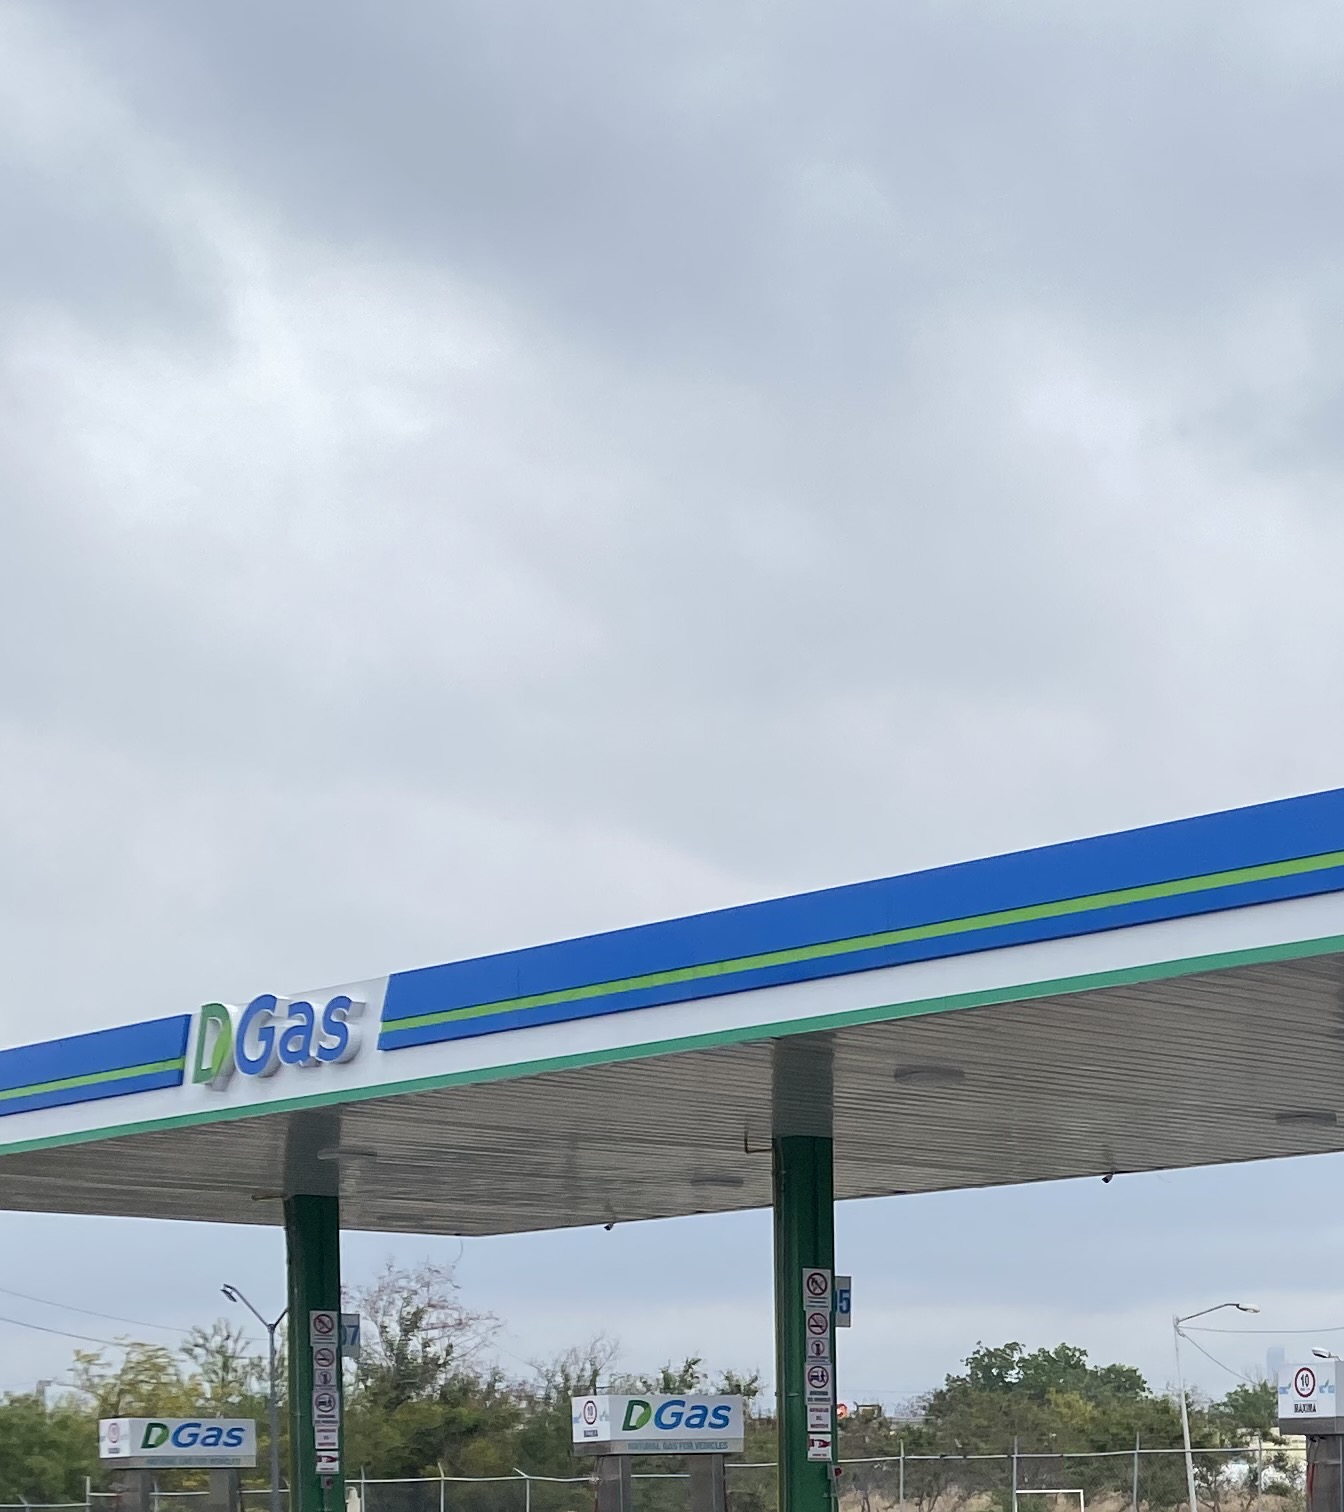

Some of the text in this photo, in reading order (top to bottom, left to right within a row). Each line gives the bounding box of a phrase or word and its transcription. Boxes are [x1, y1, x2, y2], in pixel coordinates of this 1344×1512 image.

[1300, 1374, 1310, 1388] 10
[622, 1399, 732, 1432] DGas
[141, 1422, 246, 1449] DGas
